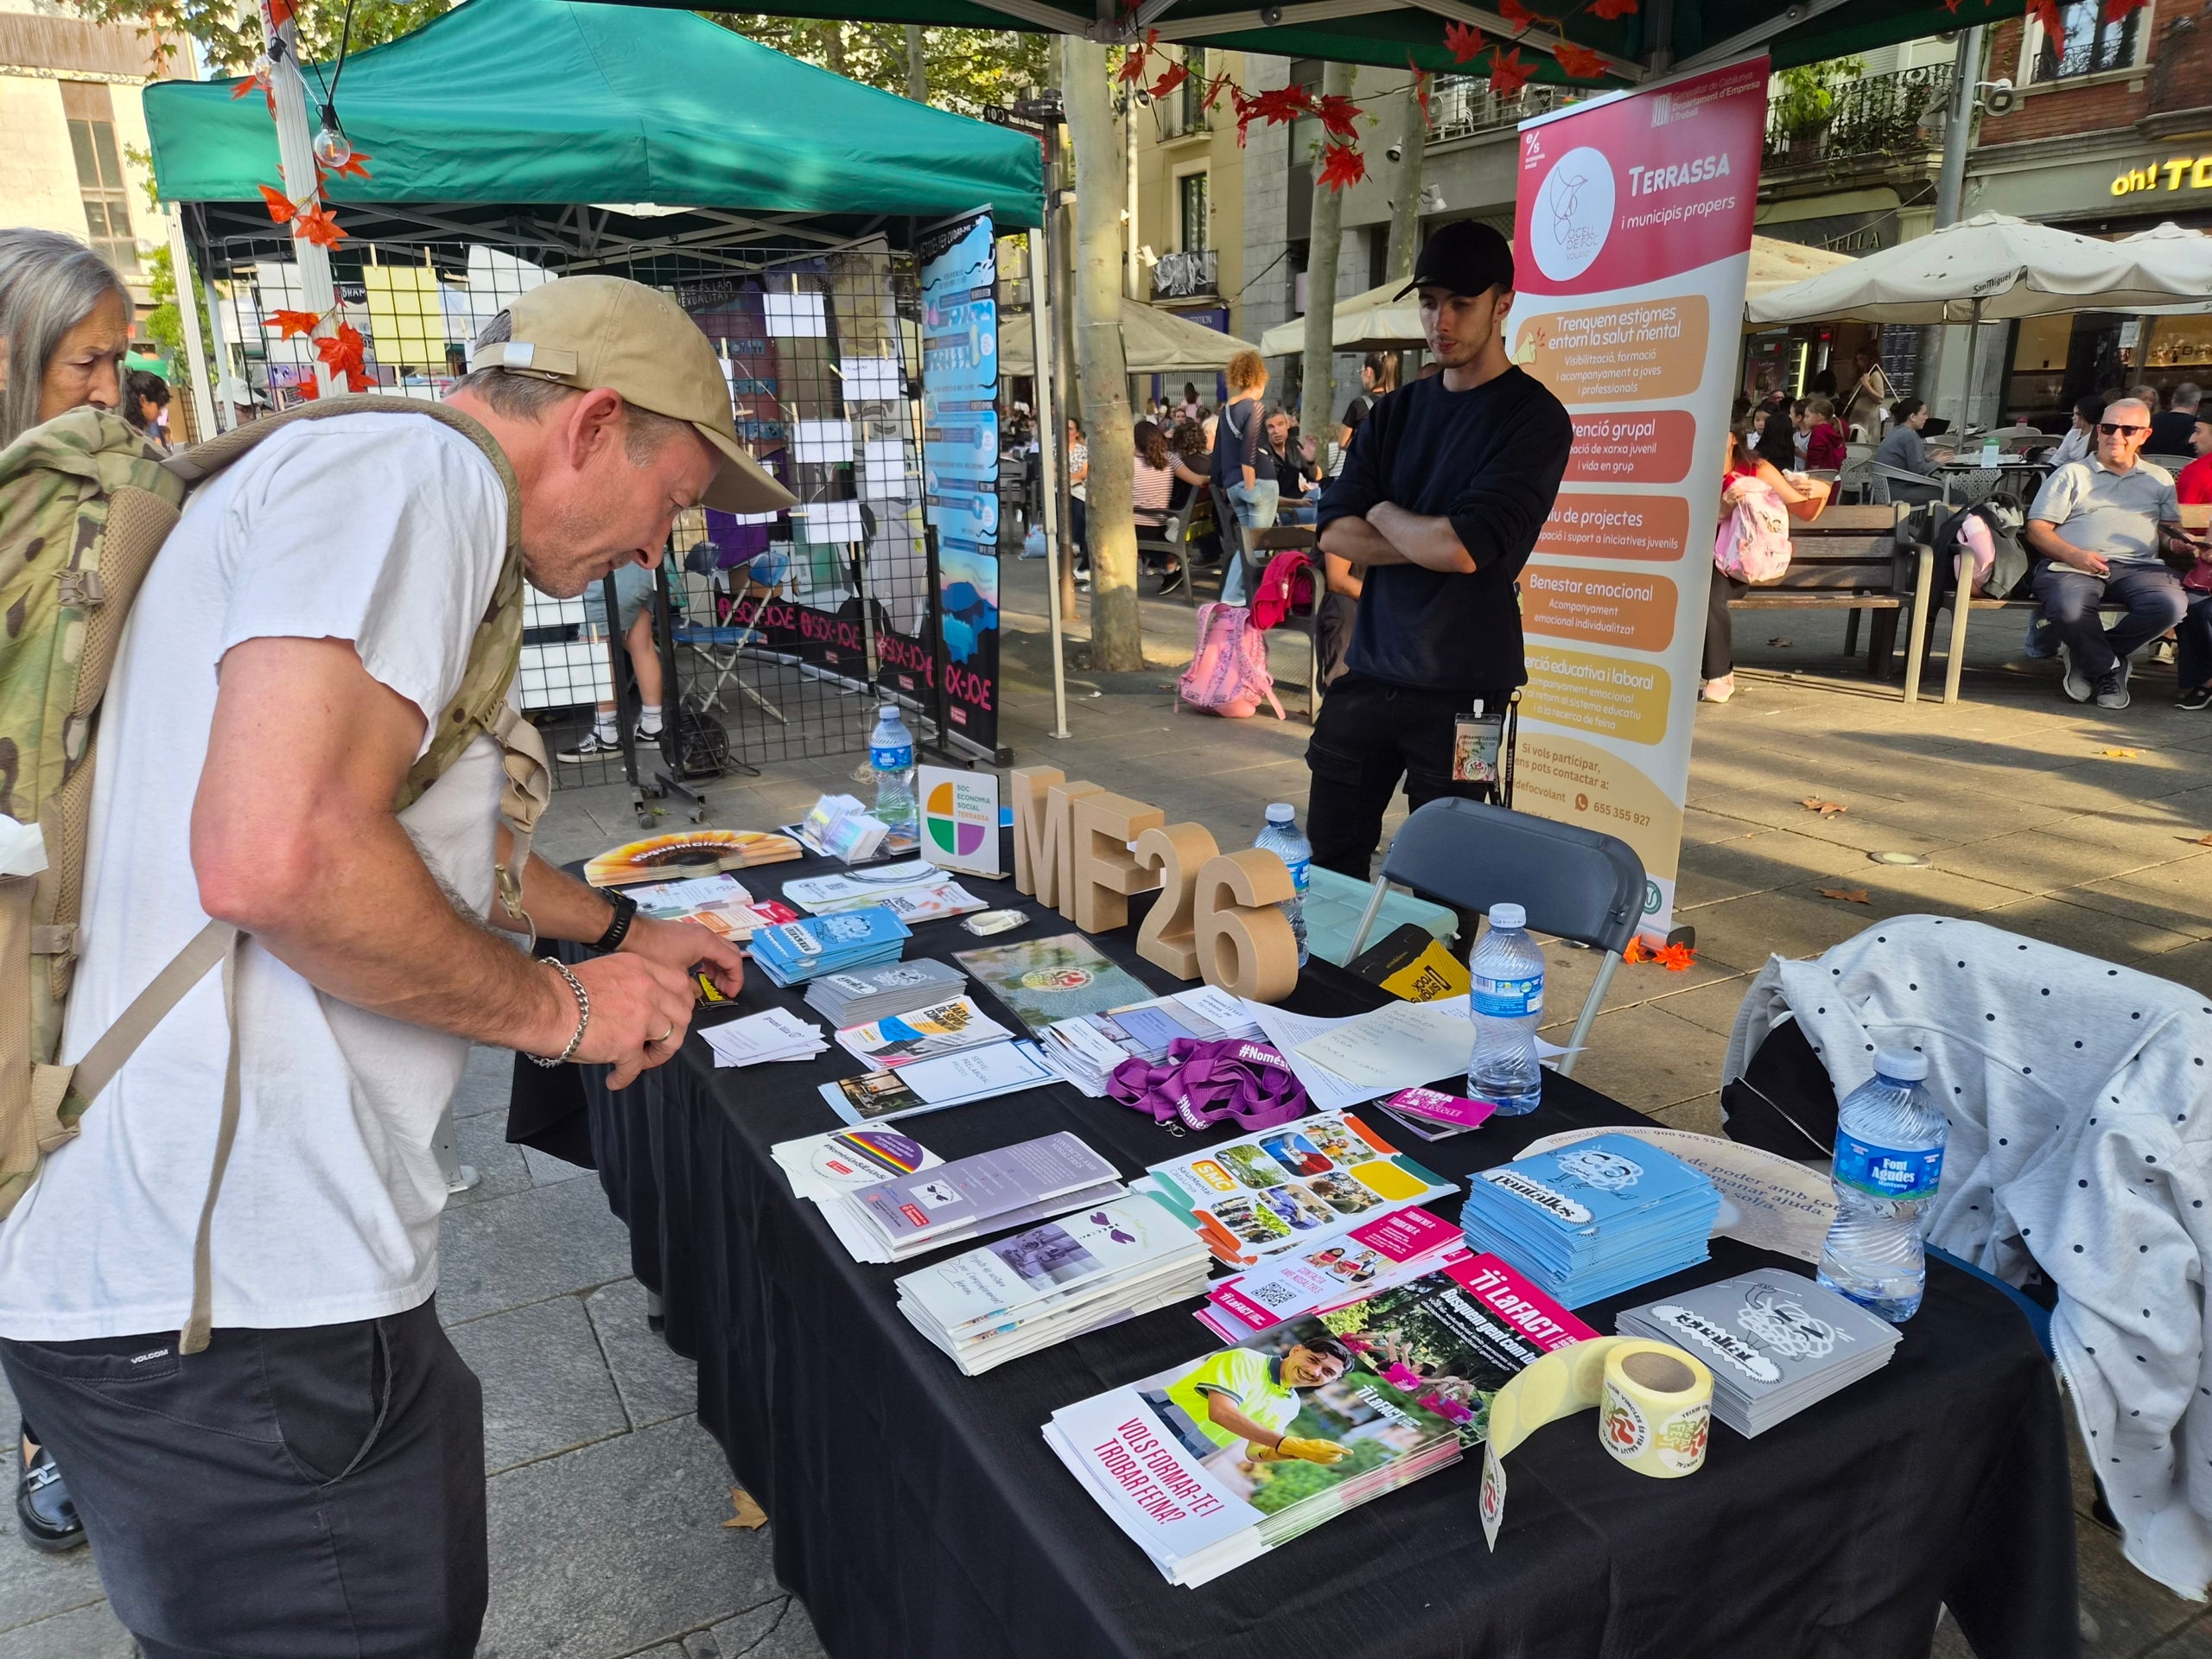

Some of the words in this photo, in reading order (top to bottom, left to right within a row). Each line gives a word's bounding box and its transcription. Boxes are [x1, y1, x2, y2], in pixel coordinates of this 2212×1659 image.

[1719, 72, 1753, 88] Catalunya
[1672, 92, 1718, 111] Departament
[1719, 80, 1760, 98] d'Empresa
[1629, 152, 1730, 197] TERRASSA
[2110, 160, 2158, 197] oh!
[1627, 205, 1689, 228] municipis
[1685, 195, 1735, 224] propers
[1824, 232, 1881, 252] VELLA
[1557, 315, 1617, 334] Trenquem
[1619, 306, 1676, 327] estigmes
[1548, 333, 1588, 350] entorn
[1590, 330, 1600, 346] la
[1602, 327, 1634, 346] salut
[1637, 321, 1681, 342] mental
[1565, 352, 1616, 366] Visibilització,
[1618, 350, 1656, 362] formació
[1560, 368, 1631, 383] acompanyament
[1639, 365, 1662, 378] joves
[1581, 383, 1638, 397] professionals
[1573, 420, 1610, 437] tenció
[1612, 418, 1656, 441] grupal
[1591, 443, 1601, 454] de
[1603, 445, 1628, 454] xarxa
[1629, 442, 1656, 457] juvenil
[1581, 461, 1599, 471] vida
[1612, 462, 1634, 474] grup
[1563, 509, 1579, 524] de
[1580, 510, 1643, 530] projectes
[1568, 533, 1594, 544] suport
[1603, 533, 1646, 547] iniciatives
[1646, 537, 1679, 550] juvenils
[1529, 574, 1582, 594] Benestar
[1585, 582, 1653, 602] emocional
[1549, 599, 1618, 616] Acompanyament
[1535, 613, 1573, 627] emocional
[1575, 617, 1635, 636] individualitzat
[1551, 658, 1605, 682] educativa
[1611, 668, 1654, 690] laboral
[1535, 691, 1560, 704] retorn
[1568, 697, 1601, 712] sistema
[1602, 705, 1641, 721] educatiu
[1589, 688, 1634, 703] emocional
[1552, 709, 1582, 722] recerca
[1583, 713, 1593, 724] de
[1595, 715, 1616, 729] feina
[1522, 743, 1531, 753] Si
[1532, 747, 1550, 760] vols
[1552, 752, 1601, 773] participar,
[1515, 759, 1529, 769] ens
[1531, 761, 1551, 775] pots
[1553, 767, 1599, 787] contactar
[1600, 780, 1610, 790] a:
[957, 793, 990, 804] ECONOMIA
[957, 803, 980, 811] SOCIAL
[958, 811, 989, 822] TERRASSA
[1593, 802, 1611, 815] 655
[1612, 807, 1631, 821] 355
[1633, 812, 1650, 827] 927
[1704, 1137, 1723, 1146] 555
[1197, 1164, 1231, 1190] SMC
[1688, 1157, 1708, 1167] de
[1712, 1166, 1764, 1185] poder
[1768, 1184, 1808, 1200] amb
[1872, 1166, 1916, 1183] Agudes
[1878, 1180, 1908, 1190] Montseny
[1732, 1192, 1777, 1211] sol/a.
[1771, 1196, 1826, 1217] ajuda.
[1440, 1288, 1487, 1326] Busquem
[1475, 1322, 1510, 1343] gent
[130, 1349, 169, 1364] VOLCOM
[1622, 1394, 1643, 1423] VINCLES
[1117, 1417, 1159, 1454] VOLS
[1141, 1448, 1219, 1513] FORMAR-TE
[1200, 1504, 1225, 1517] I
[1094, 1437, 1149, 1491] TROBAR
[1131, 1484, 1187, 1525] FEINA?
